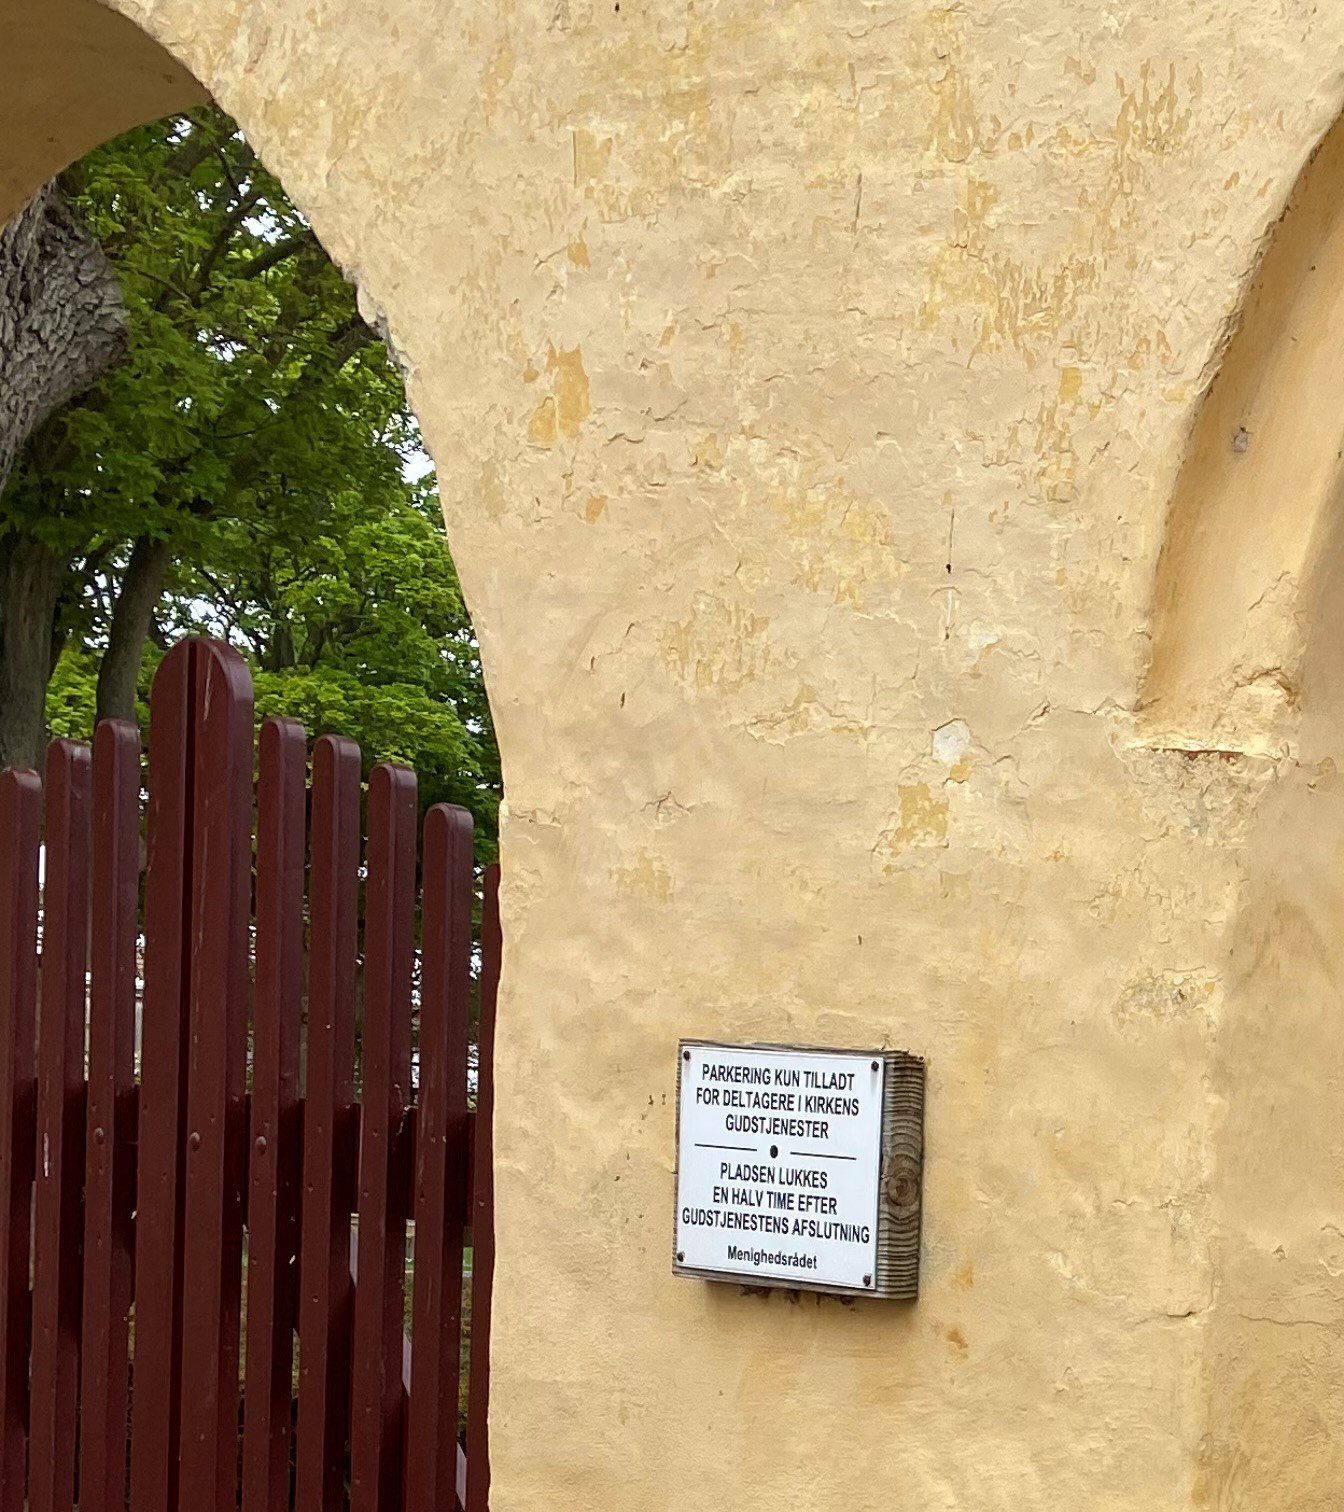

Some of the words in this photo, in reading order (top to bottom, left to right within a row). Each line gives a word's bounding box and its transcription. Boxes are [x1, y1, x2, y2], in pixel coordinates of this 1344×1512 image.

[702, 1064, 771, 1085] PARKERING
[775, 1069, 800, 1087] KUN
[804, 1071, 855, 1091] TILLADT
[696, 1088, 720, 1105] FOR
[723, 1090, 795, 1112] DELTAGERE
[798, 1095, 802, 1112] I
[805, 1096, 859, 1116] KIRKENS
[726, 1114, 829, 1139] GUDSTJENESTER
[720, 1162, 775, 1184] PLADSEN
[779, 1168, 828, 1189] LUKKES
[713, 1186, 728, 1204] EN
[732, 1187, 764, 1207] HALV
[767, 1191, 794, 1211] TIME
[798, 1194, 837, 1215] EFTER
[682, 1207, 789, 1234] GUDSTJENESTENS
[792, 1218, 870, 1244] AFSLUTNING
[727, 1245, 817, 1270] Menighedsrådet
